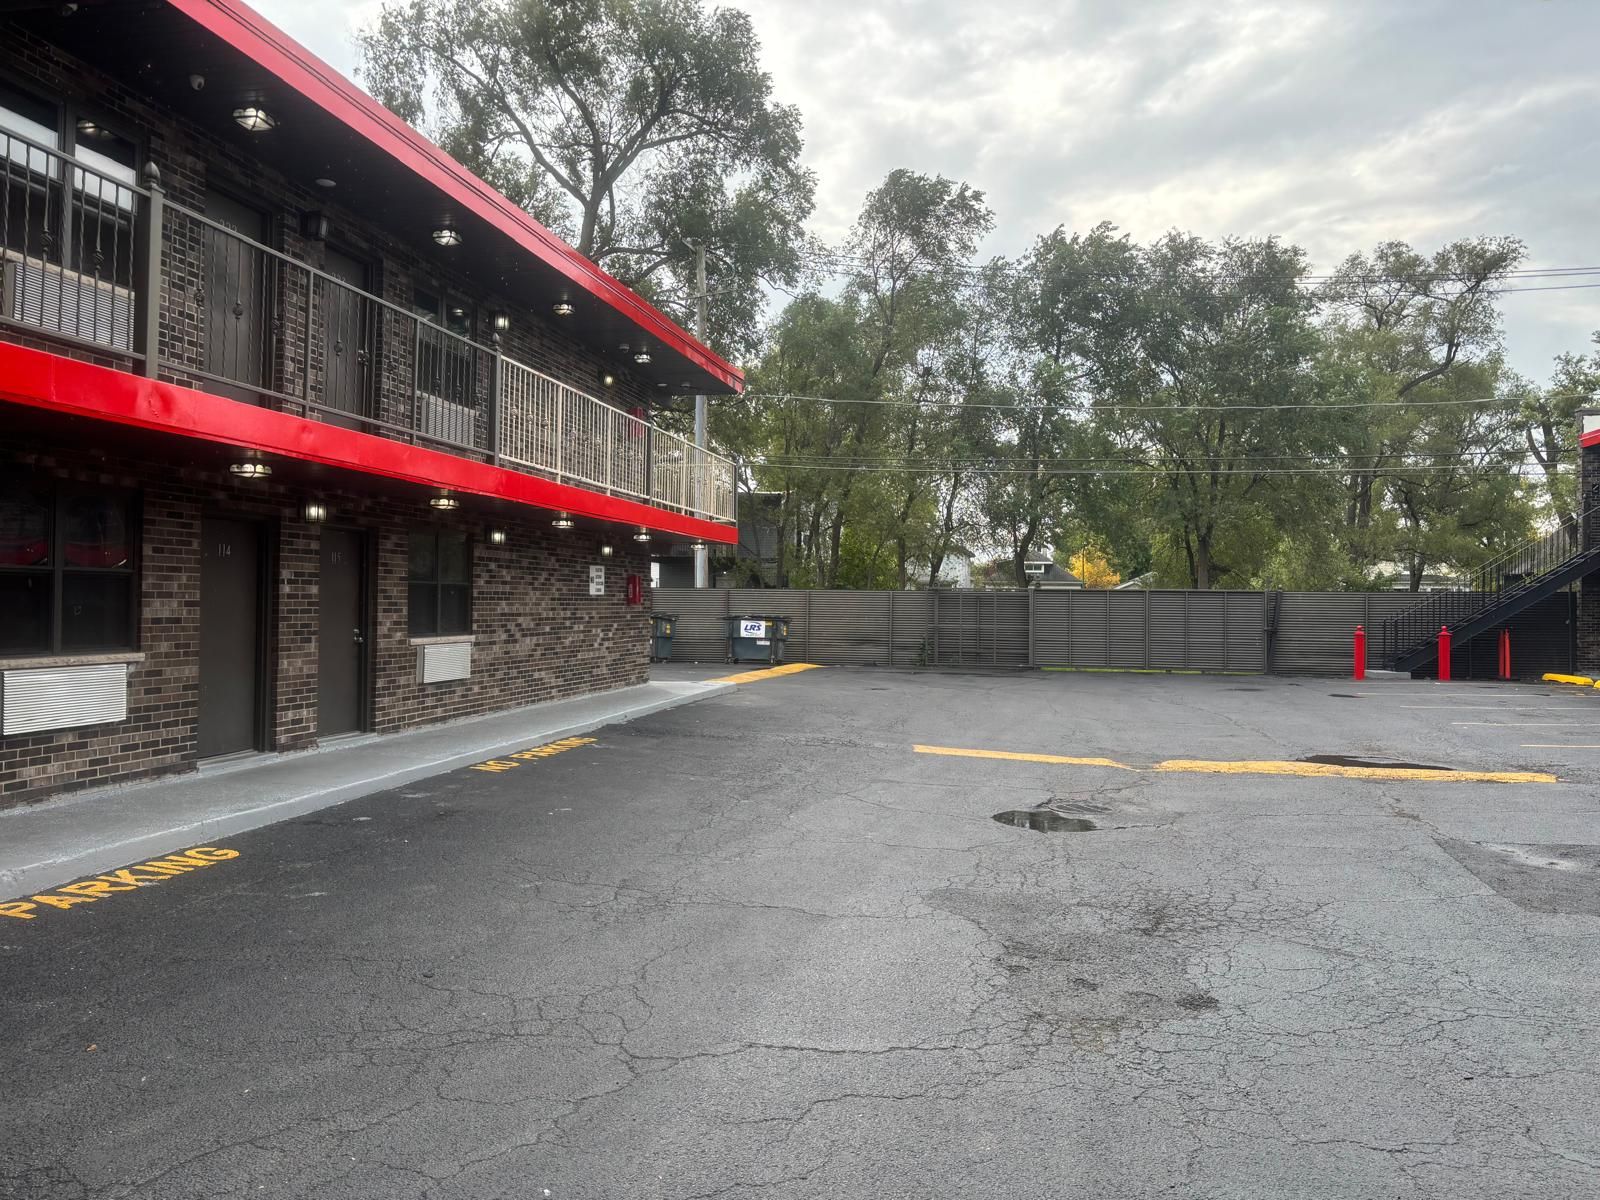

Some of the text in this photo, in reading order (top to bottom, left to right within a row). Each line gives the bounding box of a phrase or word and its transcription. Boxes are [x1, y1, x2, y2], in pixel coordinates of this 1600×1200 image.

[744, 623, 762, 632] LRS
[469, 736, 598, 773] NO PARKING
[0, 847, 240, 919] PARKING
